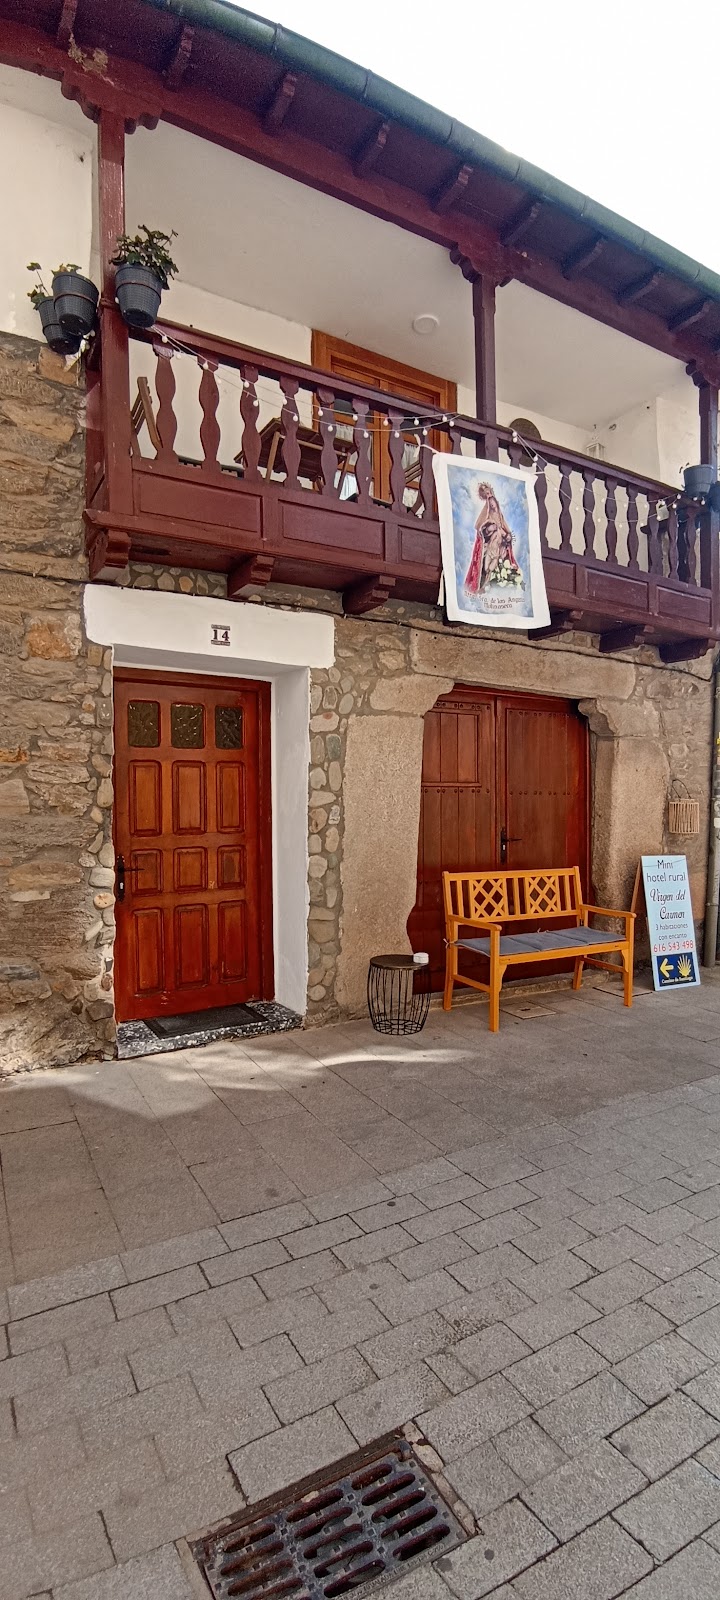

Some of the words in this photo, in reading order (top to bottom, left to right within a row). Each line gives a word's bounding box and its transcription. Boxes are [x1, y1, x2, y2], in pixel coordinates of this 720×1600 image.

[213, 629, 229, 641] 14
[657, 859, 673, 869] Mini
[646, 872, 666, 882] hotel
[668, 872, 686, 881] rural
[650, 888, 673, 905] Virgen
[676, 889, 685, 900] del
[659, 906, 685, 919] Carmen
[653, 943, 666, 952] 616
[668, 942, 680, 951] 543
[682, 940, 693, 949] 498
